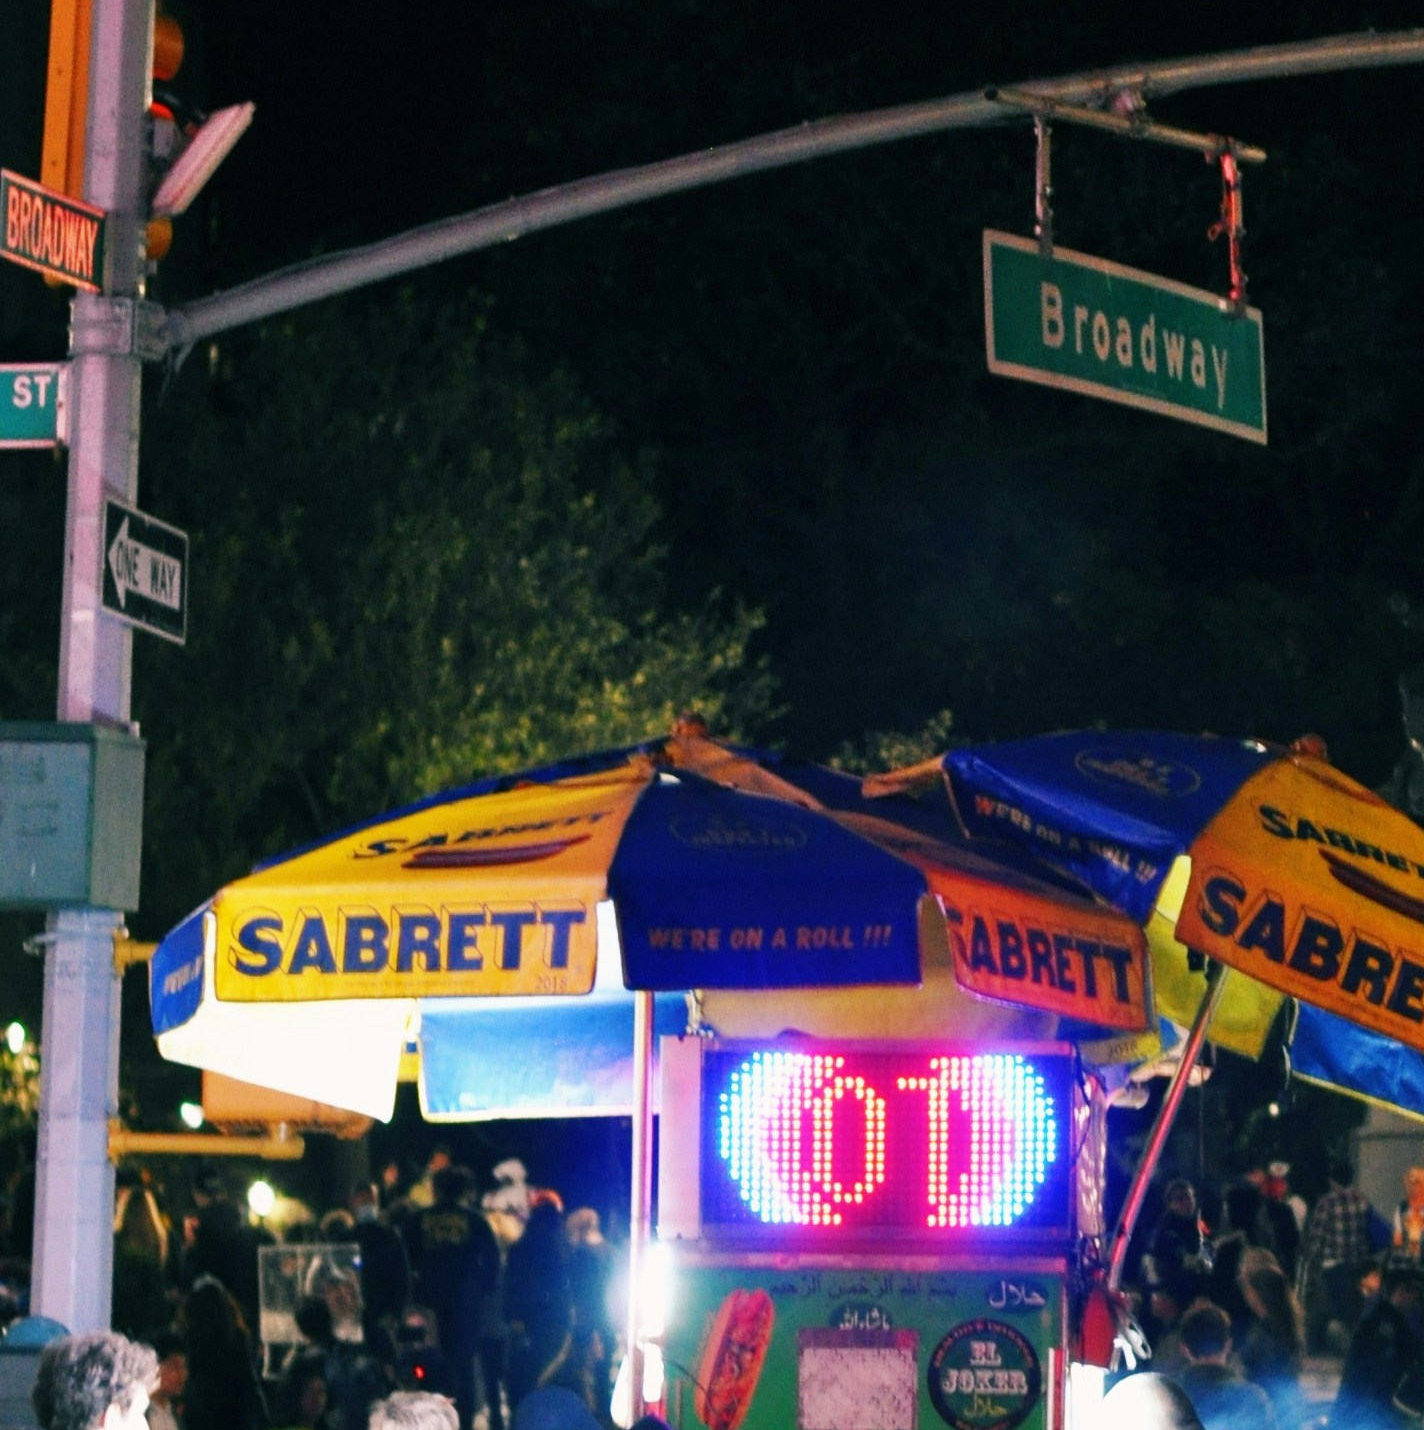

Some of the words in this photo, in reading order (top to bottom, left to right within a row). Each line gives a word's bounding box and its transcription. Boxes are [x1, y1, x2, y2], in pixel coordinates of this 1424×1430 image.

[6, 185, 99, 280] BROADWAY
[1040, 281, 1228, 409] Broadway
[12, 375, 52, 408] ST
[116, 540, 140, 588] ONE
[150, 556, 176, 603] WAY
[229, 899, 587, 977] SABRETT
[648, 925, 721, 952] WE'RE
[729, 926, 764, 951] ON
[770, 926, 787, 950] A
[795, 924, 855, 951] ROLL
[988, 1280, 1046, 1309] حلال
[969, 1339, 1002, 1367] EL
[942, 1367, 1029, 1395] JOKER
